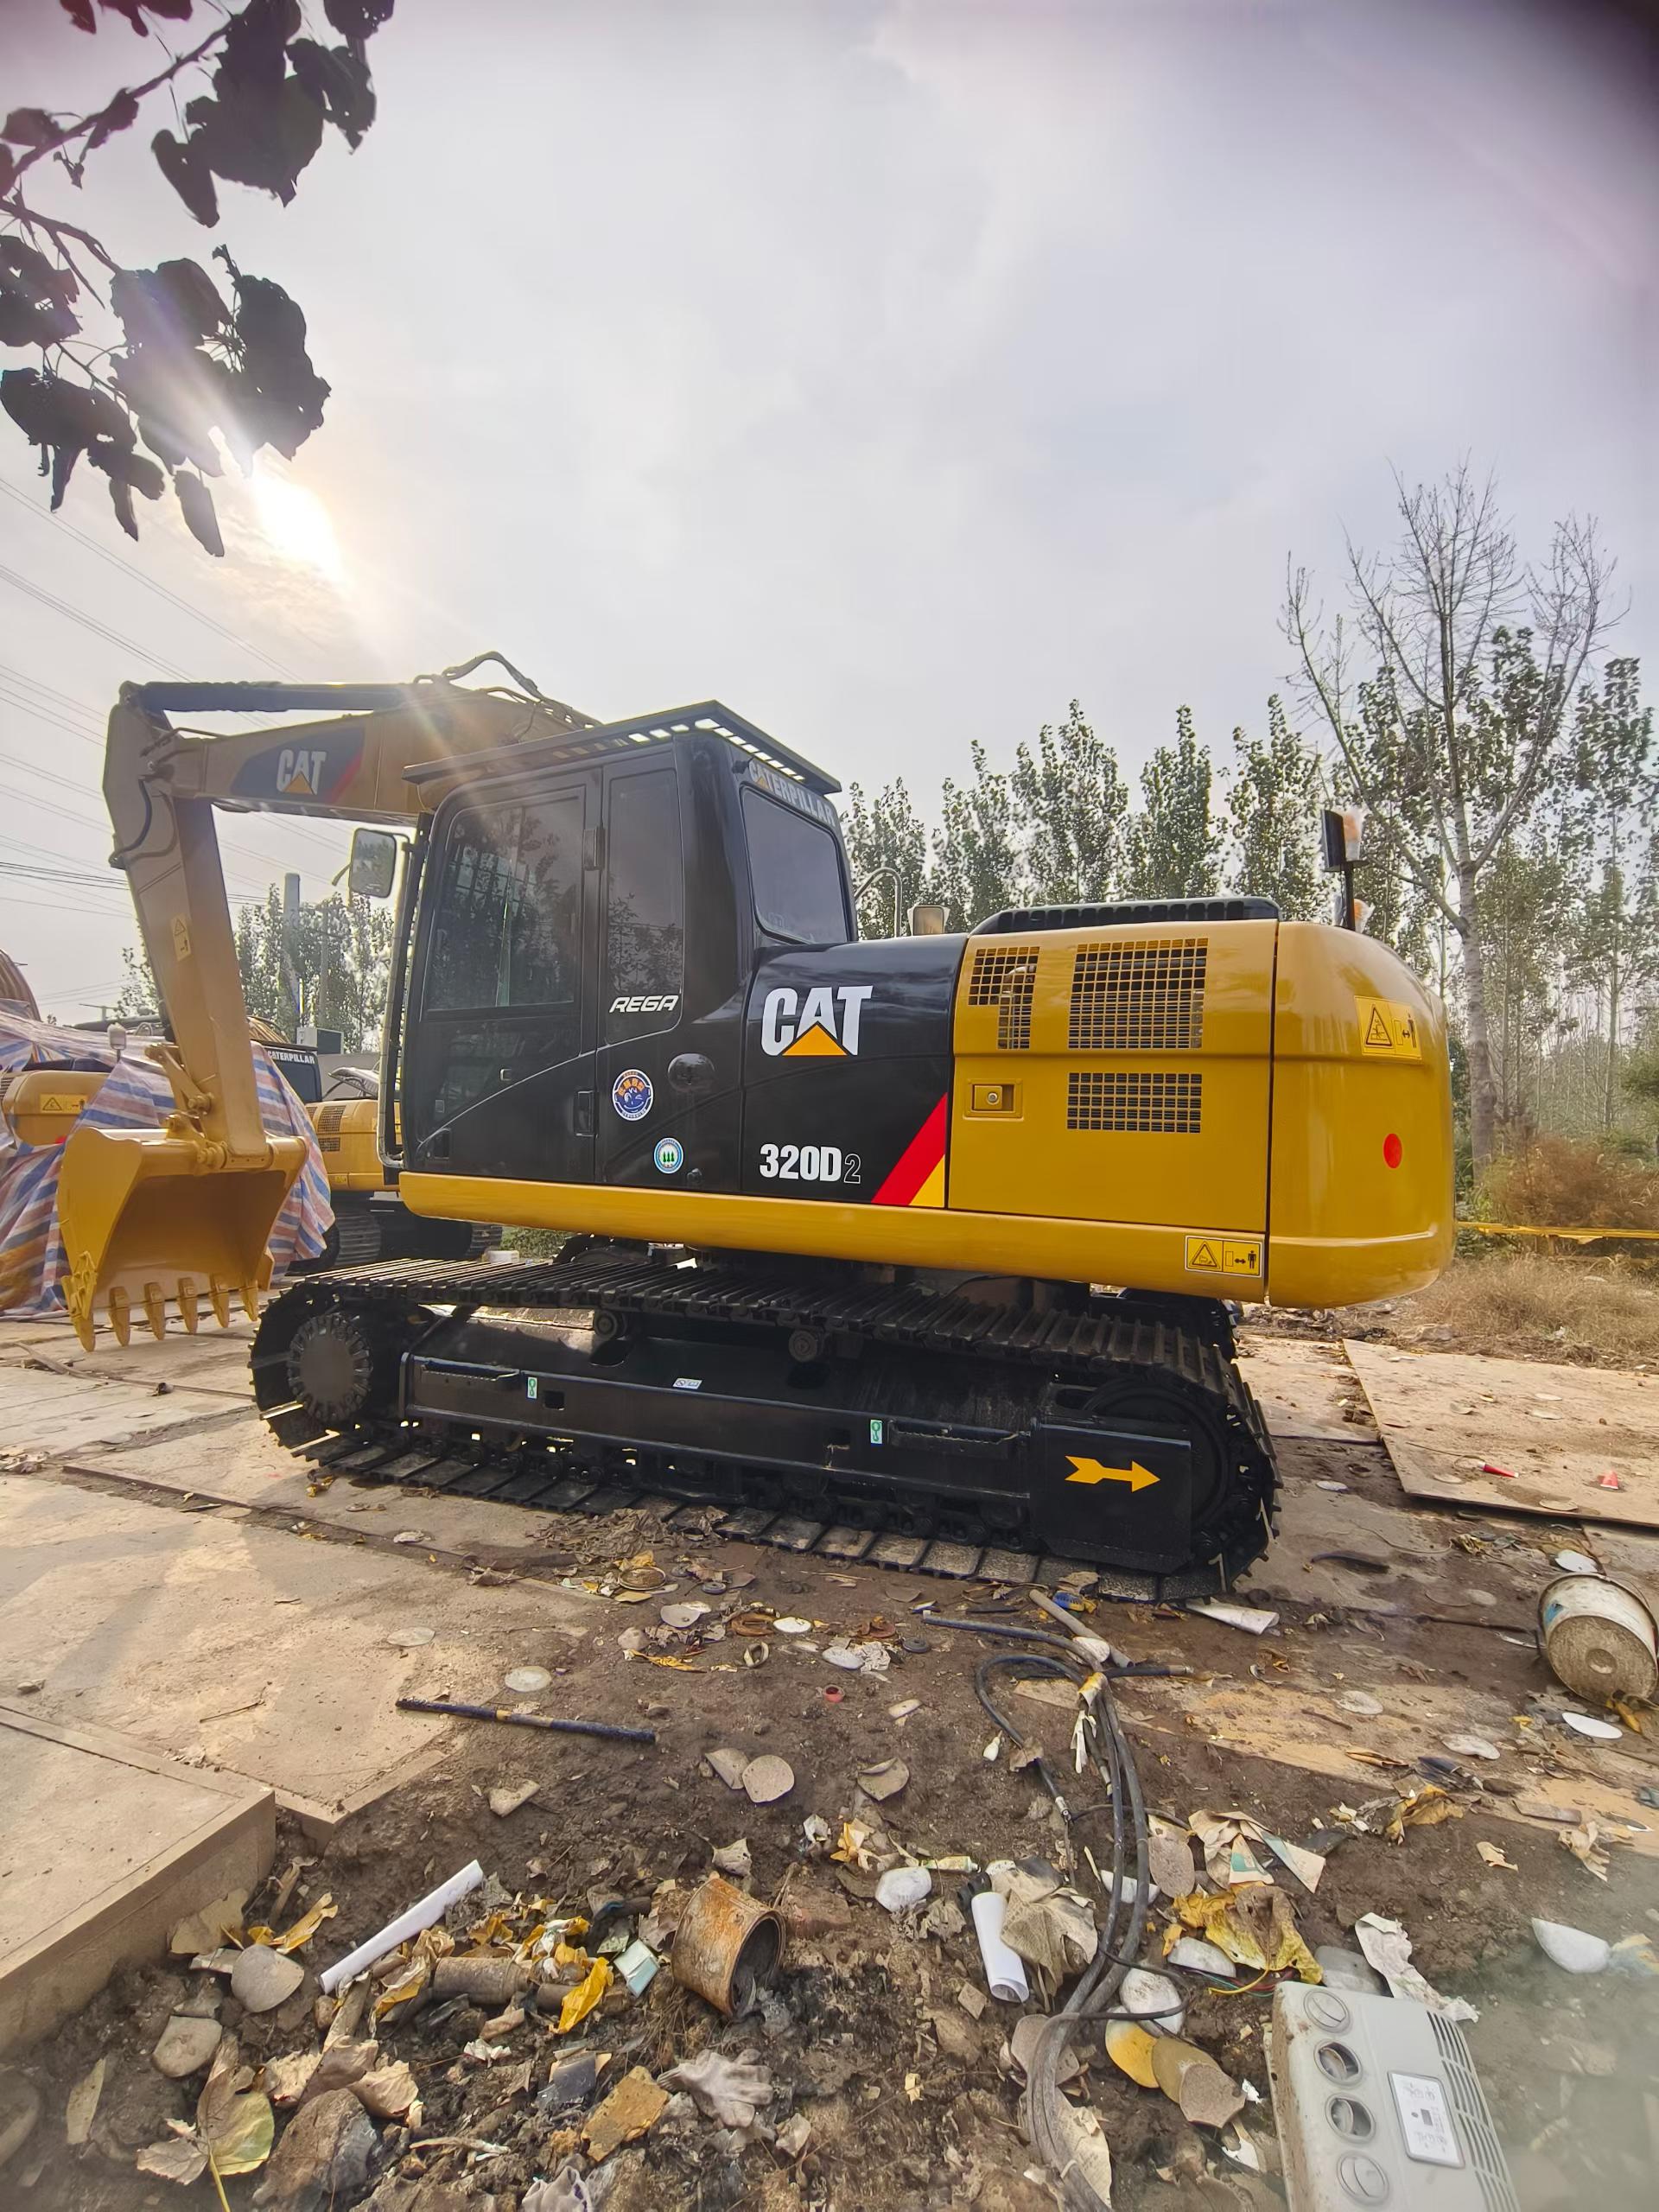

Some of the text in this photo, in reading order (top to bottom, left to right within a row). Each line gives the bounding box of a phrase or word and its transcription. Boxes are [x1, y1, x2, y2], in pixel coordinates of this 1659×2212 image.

[276, 749, 327, 795] CAT
[748, 760, 836, 827] CATERPILLAR
[608, 995, 679, 1013] REGA
[761, 985, 874, 1056] CAT
[267, 1050, 315, 1064] CATERPILLAR
